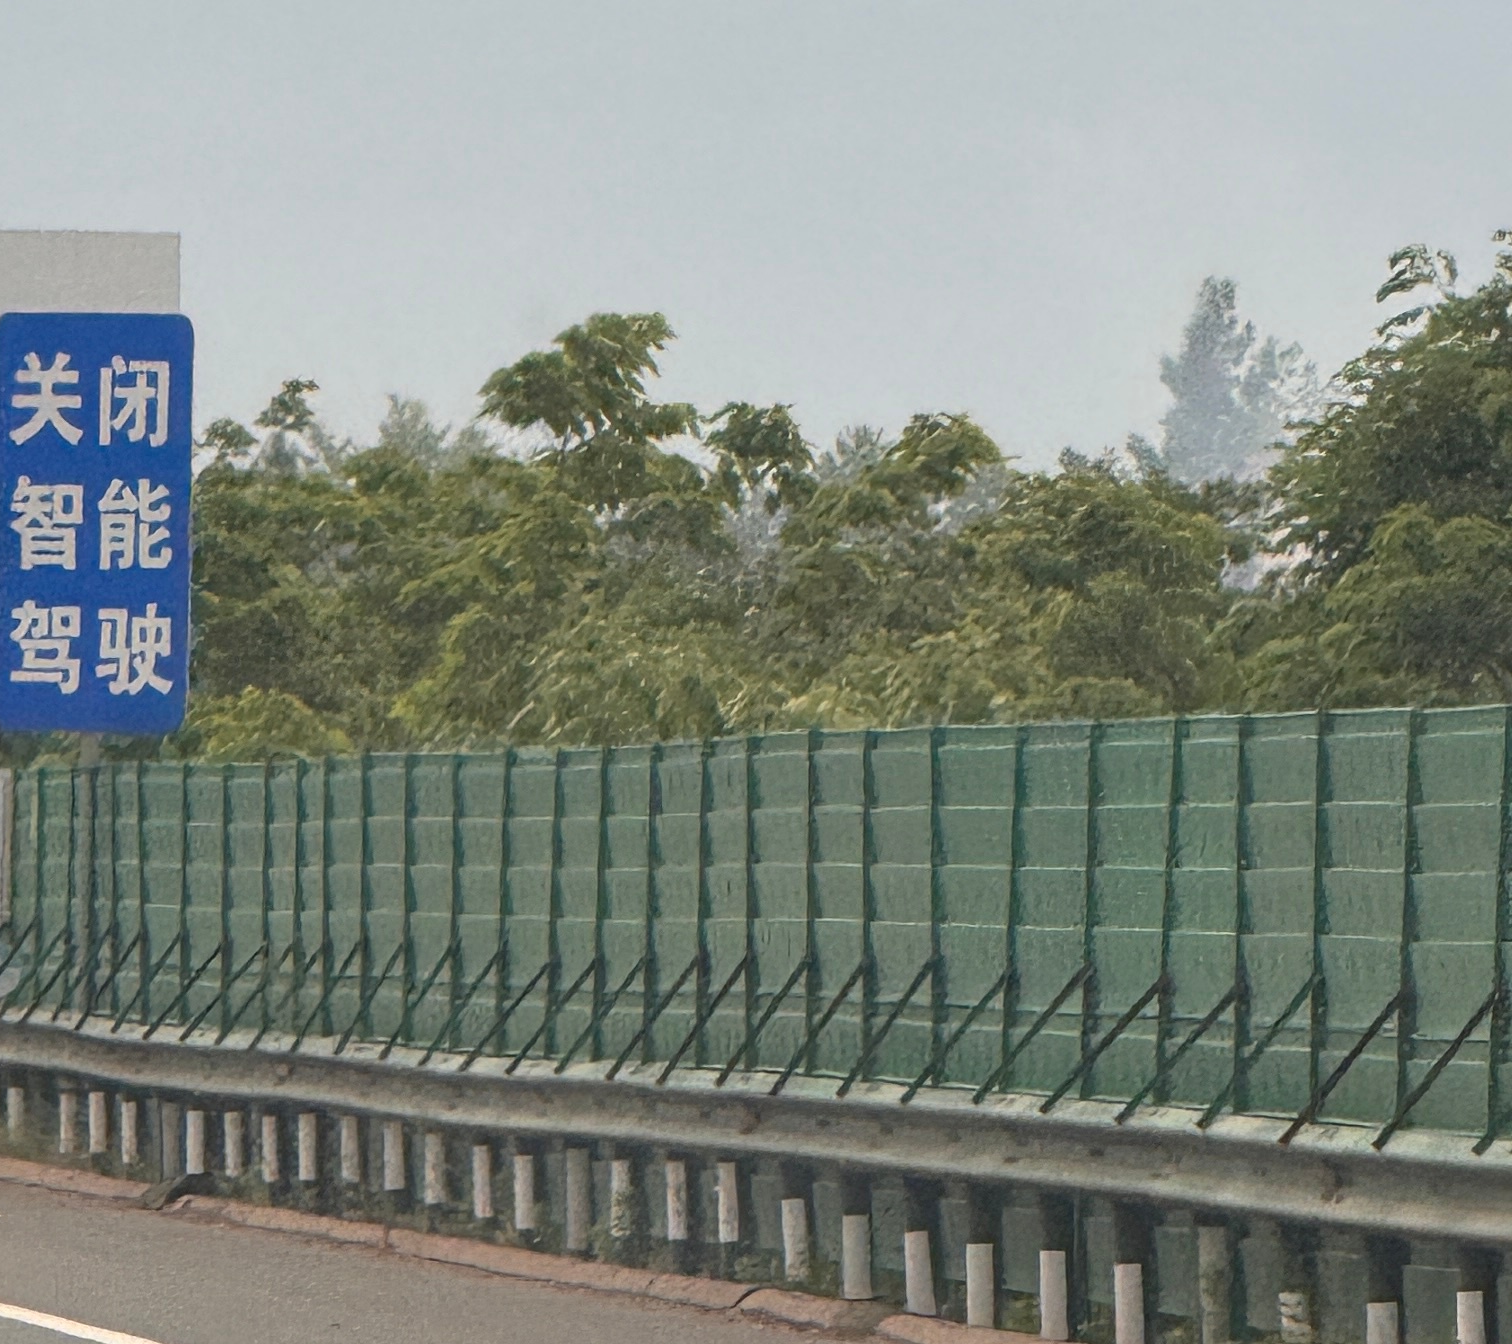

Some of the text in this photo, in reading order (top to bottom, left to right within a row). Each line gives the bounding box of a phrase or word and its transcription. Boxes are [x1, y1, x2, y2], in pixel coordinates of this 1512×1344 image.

[9, 351, 170, 447] 关闭
[9, 475, 173, 571] 智能
[9, 599, 173, 696] 驾驶
